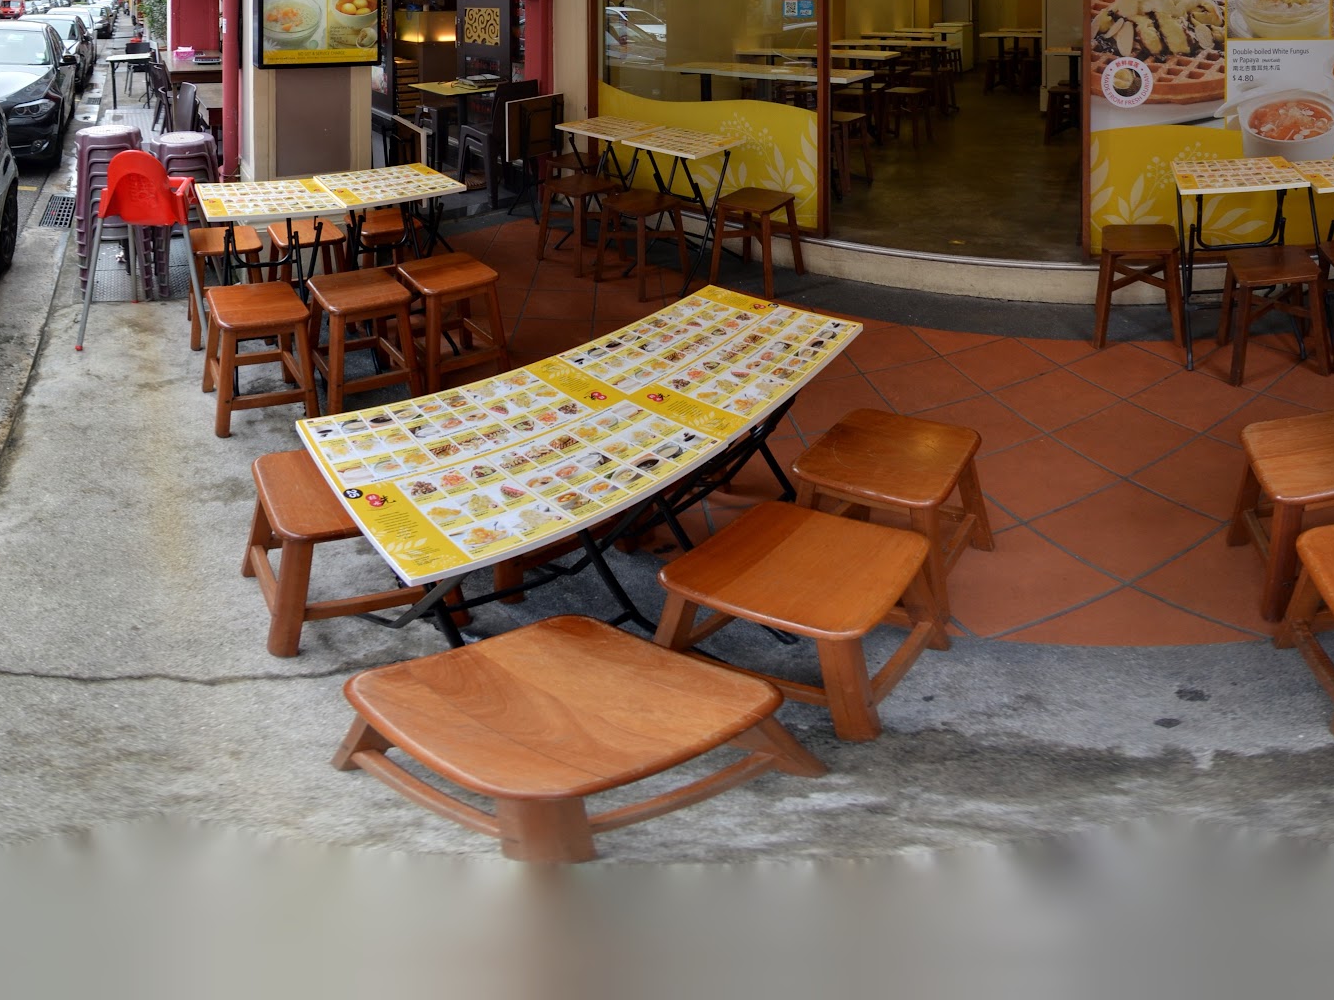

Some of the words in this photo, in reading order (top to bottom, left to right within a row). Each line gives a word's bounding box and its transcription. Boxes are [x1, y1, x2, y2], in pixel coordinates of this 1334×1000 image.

[1289, 48, 1309, 56] Fungus
[1239, 56, 1259, 65] Papaya
[1237, 74, 1254, 82] 4.80
[1108, 91, 1124, 105] FROM
[1124, 95, 1143, 106] FRESH
